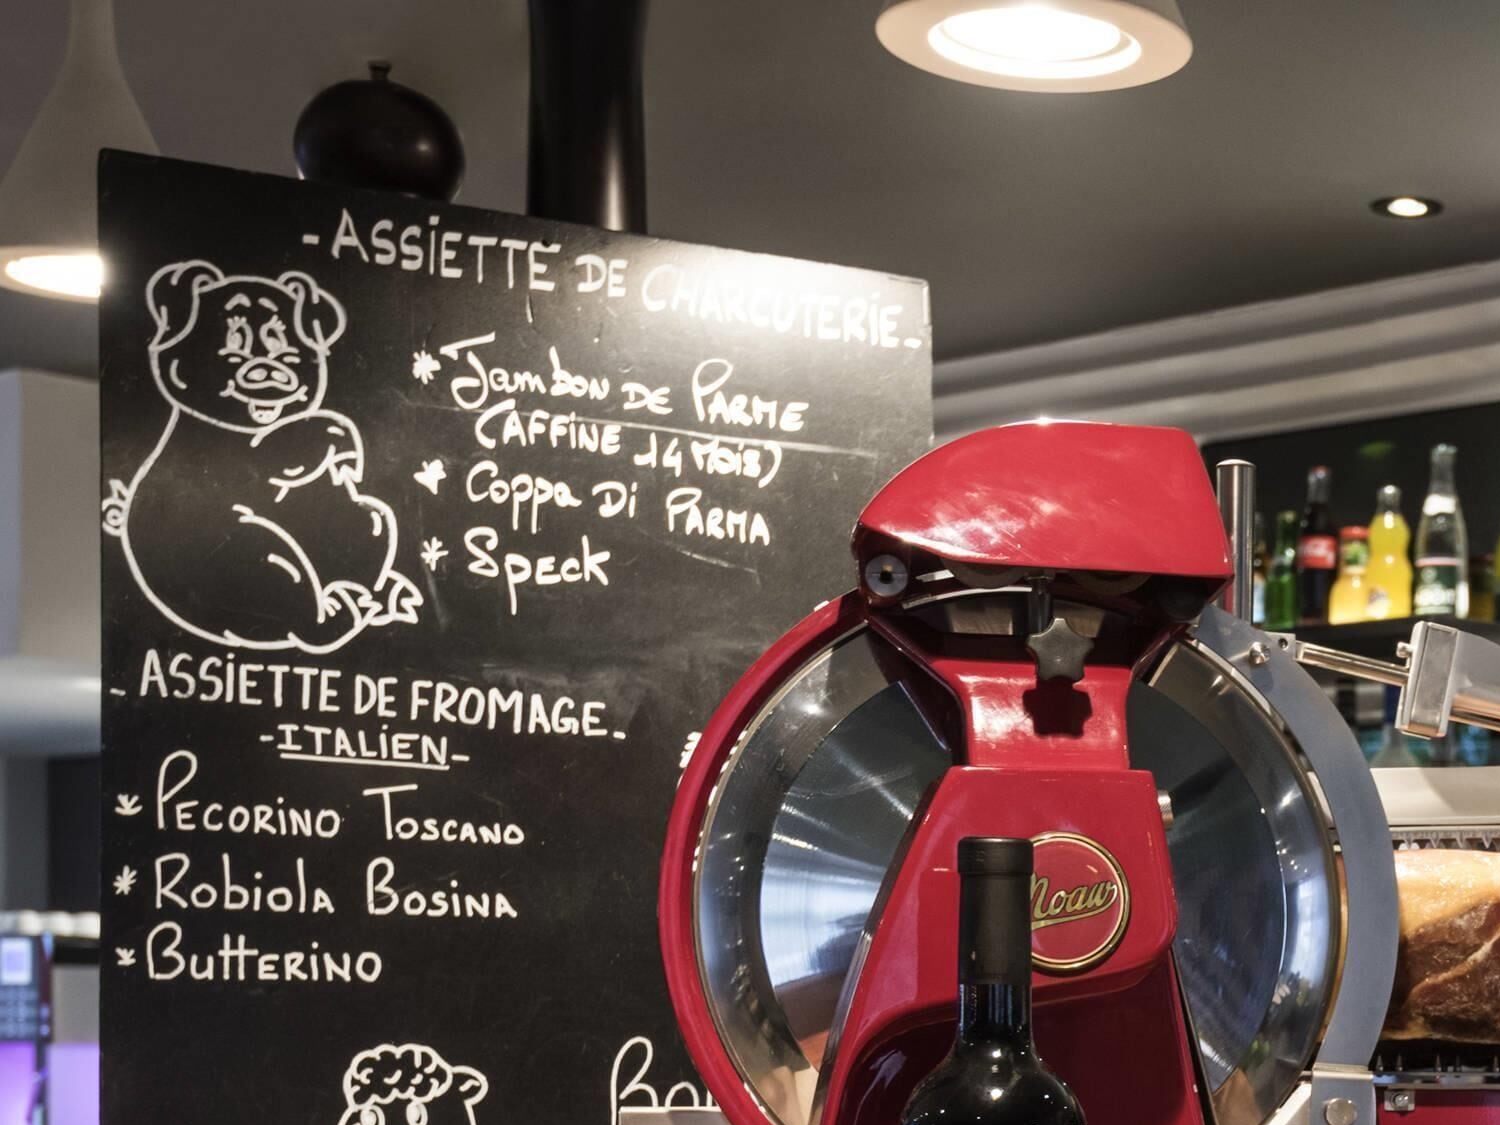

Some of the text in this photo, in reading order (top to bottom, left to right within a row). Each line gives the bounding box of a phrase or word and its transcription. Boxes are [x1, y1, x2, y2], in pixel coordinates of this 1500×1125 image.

[575, 254, 628, 297] DE
[621, 382, 673, 415] DE
[692, 358, 809, 431] PARME
[466, 460, 771, 546] Coppa Di PARMA
[464, 526, 611, 615] Speck
[355, 674, 398, 717] DE
[157, 750, 525, 844] PECORINO TOSCANO
[154, 853, 518, 918] Robiola BOSINA
